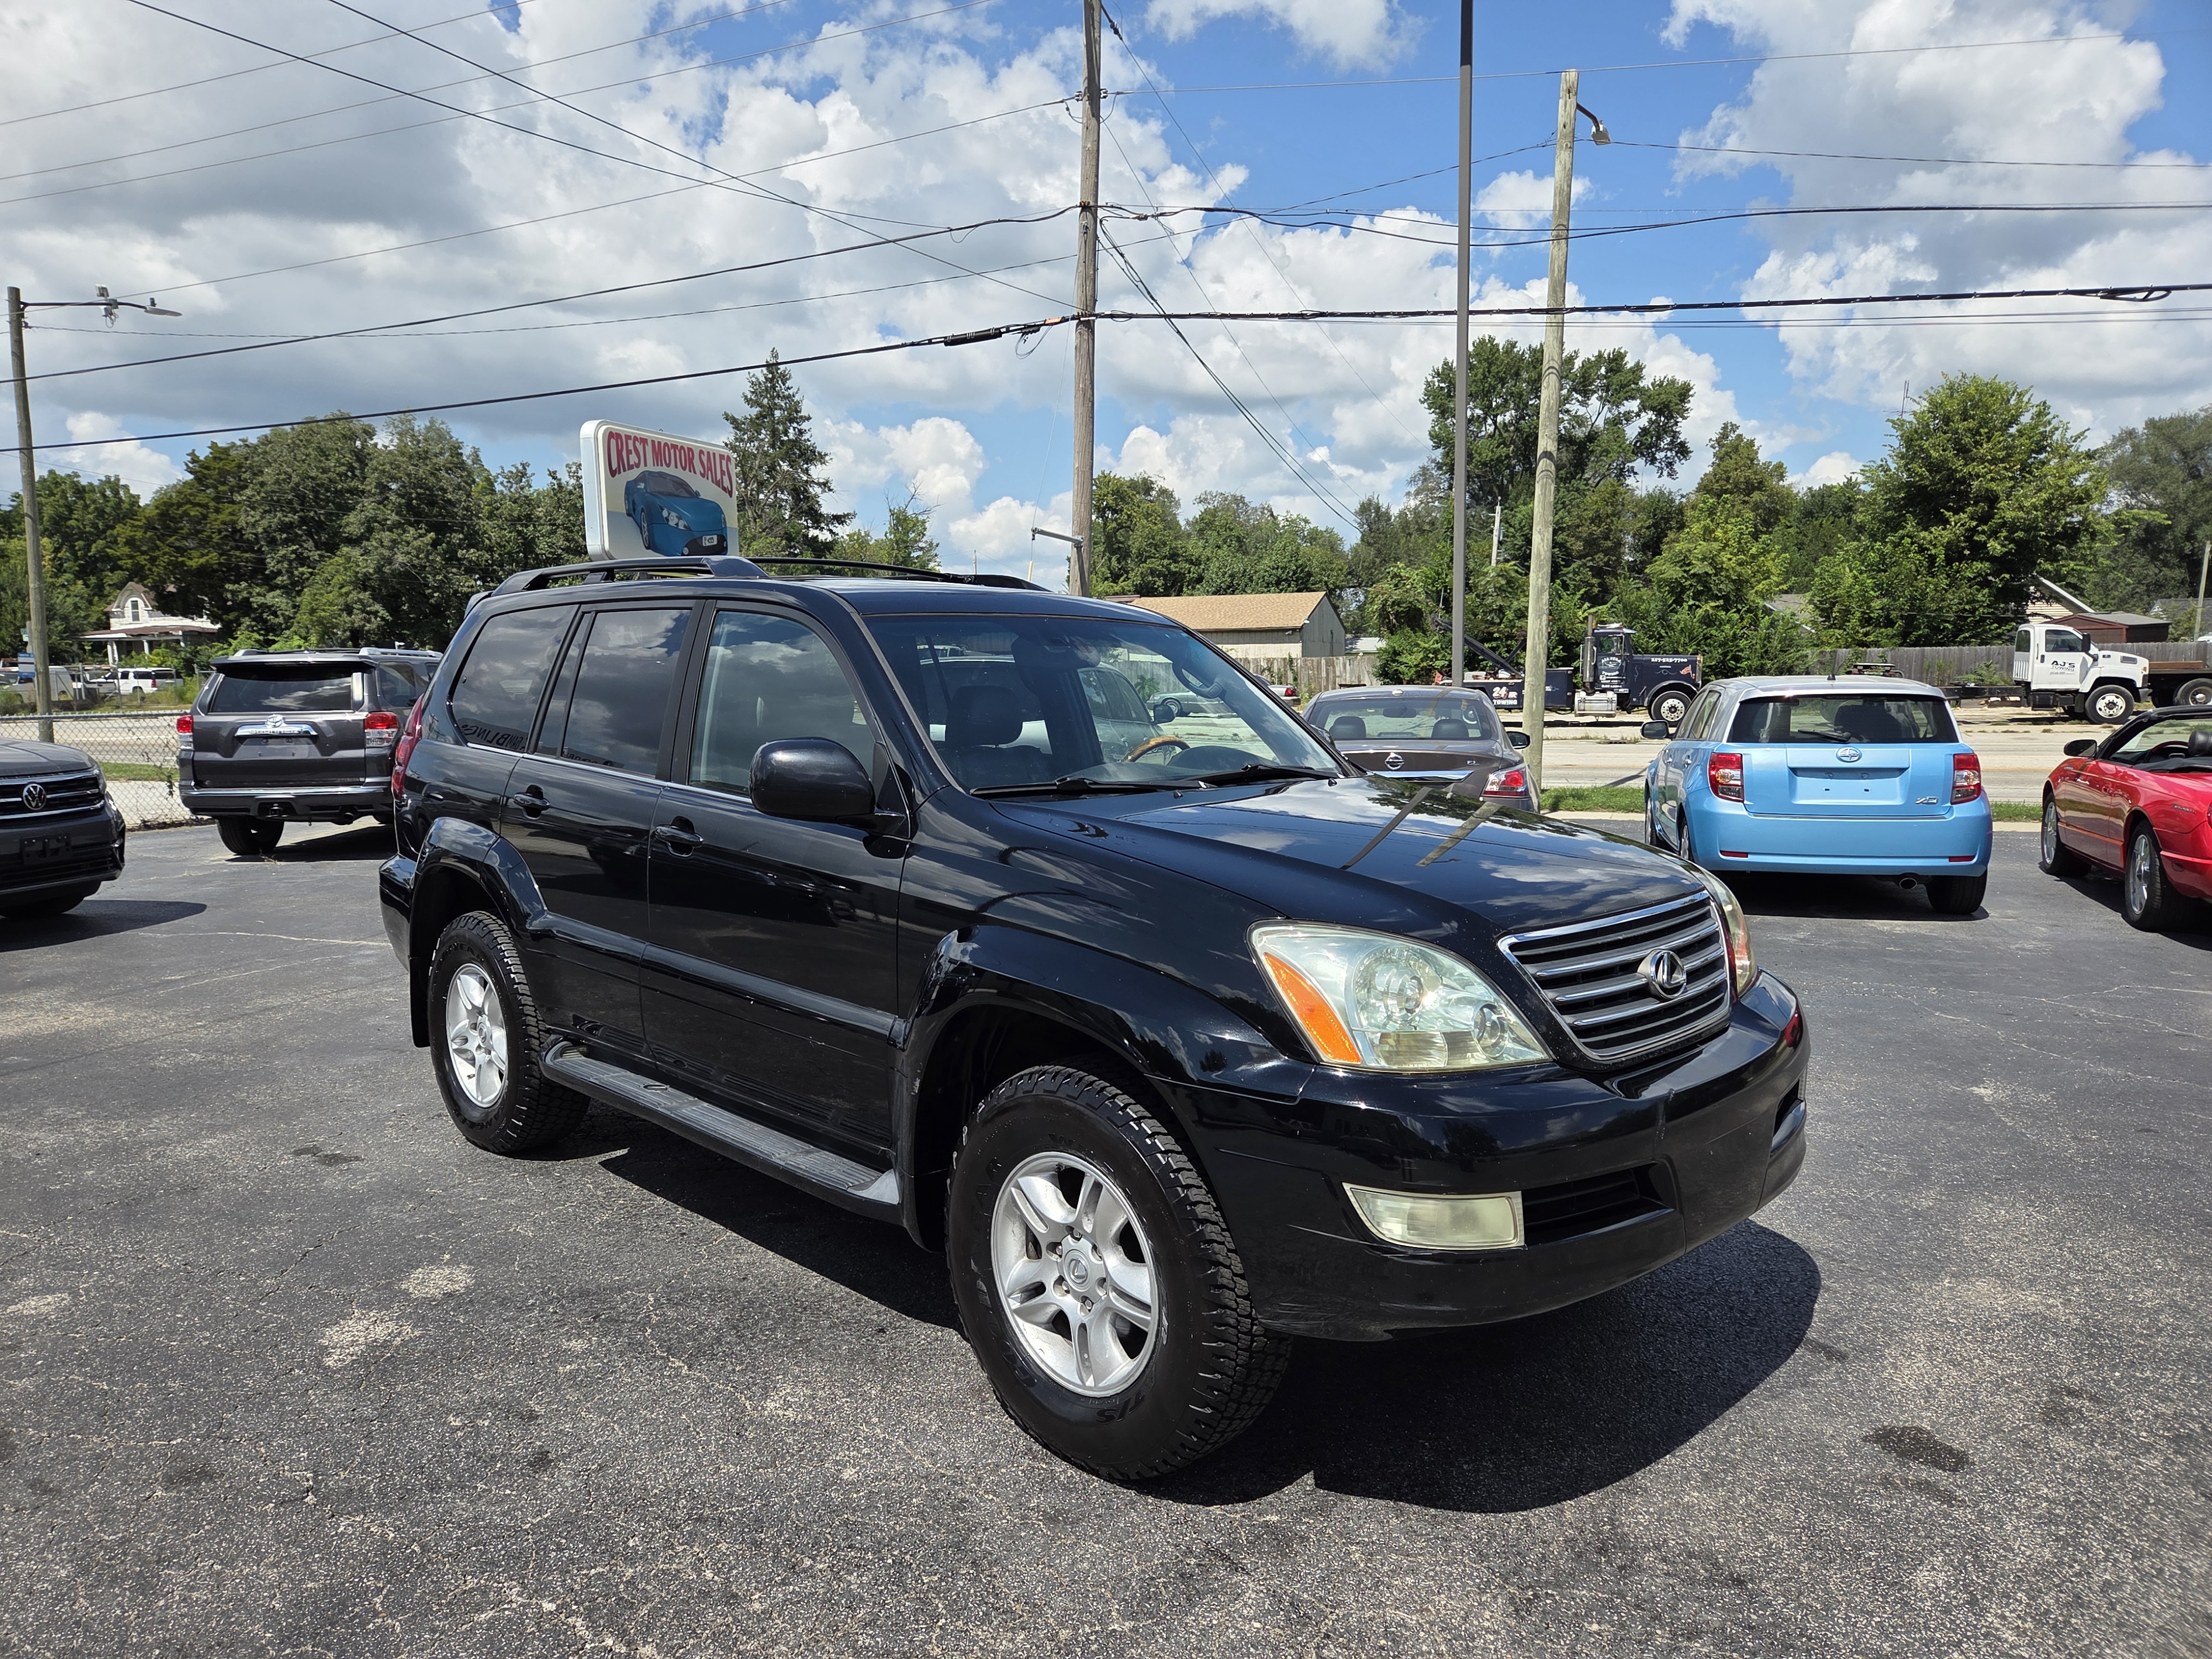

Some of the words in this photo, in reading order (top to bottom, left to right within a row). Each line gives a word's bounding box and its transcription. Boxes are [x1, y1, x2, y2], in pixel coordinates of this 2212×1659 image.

[607, 431, 648, 478] CREST
[651, 440, 697, 475] MOTOR
[698, 449, 733, 498] SALES
[1492, 686, 1509, 699] 24
